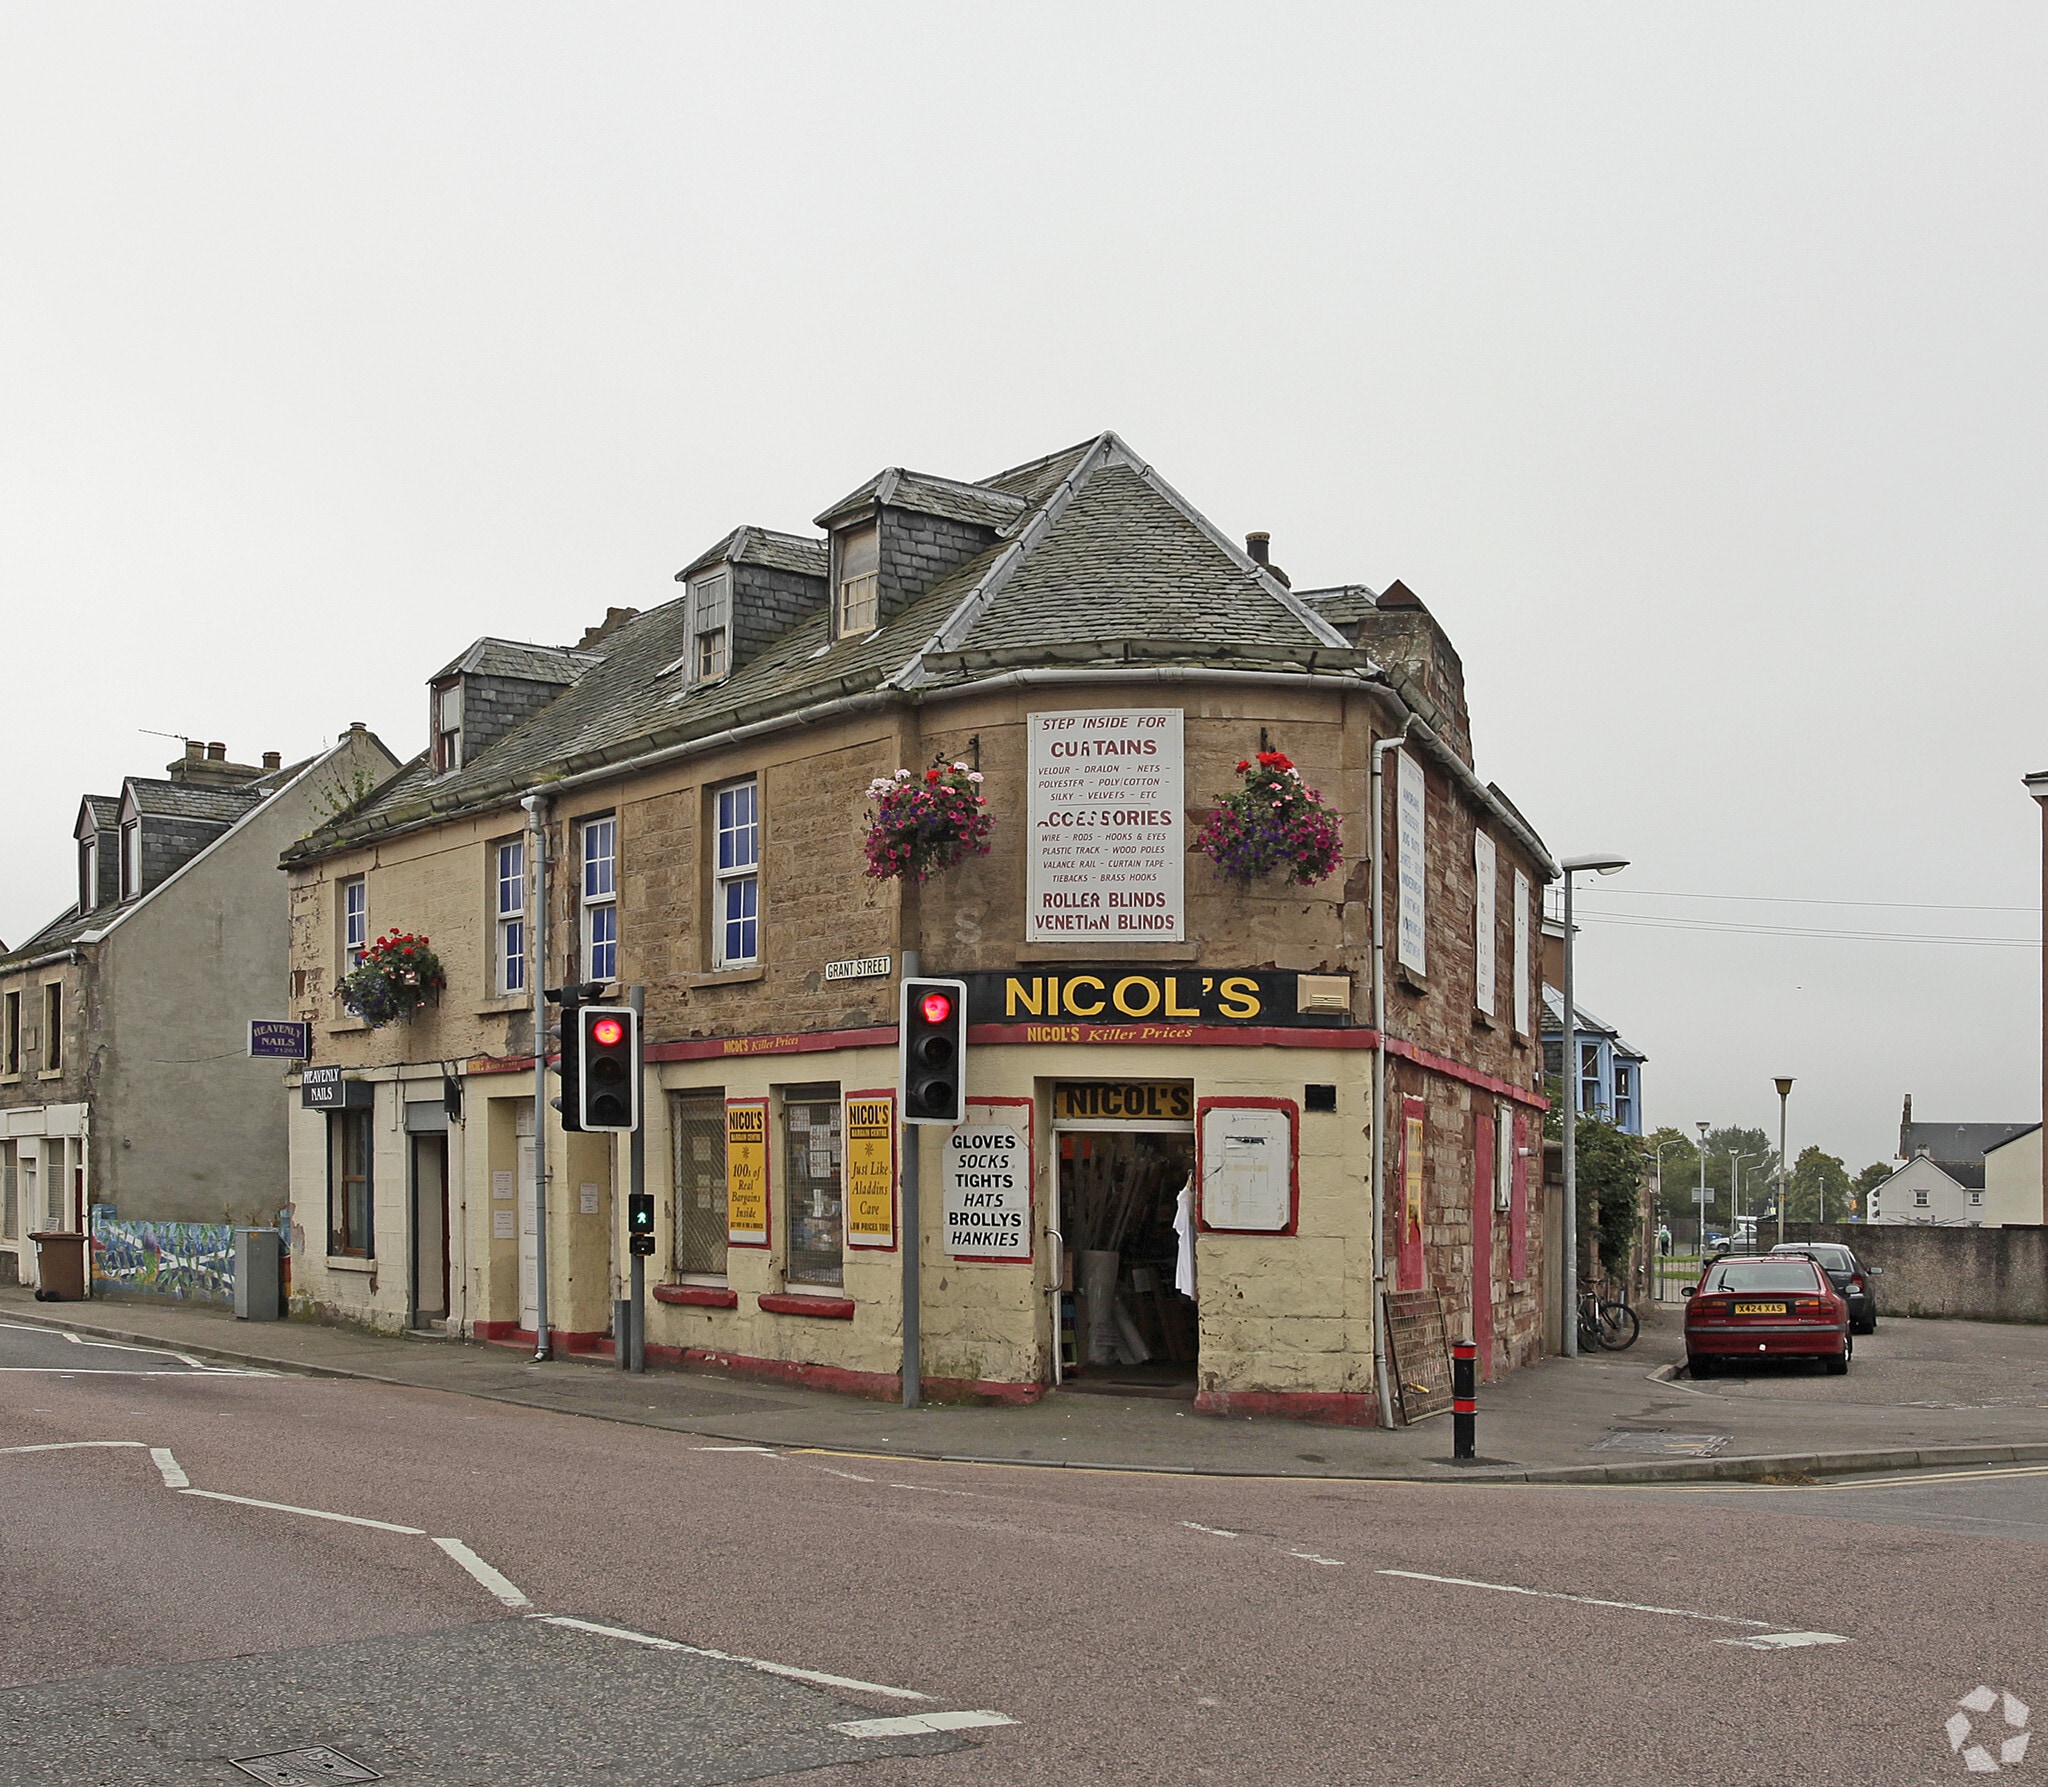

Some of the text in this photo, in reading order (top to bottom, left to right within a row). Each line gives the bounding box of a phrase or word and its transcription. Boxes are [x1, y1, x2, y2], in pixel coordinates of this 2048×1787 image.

[1043, 716, 1167, 730] STEP INSIDE FOR
[1038, 766, 1070, 775] VELOUR
[1084, 765, 1120, 774] DRALON
[1038, 780, 1084, 788] POLYESTER
[1050, 791, 1158, 801] SILKY VELVETS ETC
[1037, 810, 1172, 827] CCESSORIES
[1041, 834, 1061, 842] WIRE
[1072, 833, 1093, 841] RODS
[1042, 847, 1072, 855] PLASTIC
[1112, 846, 1136, 854] WOOD
[1079, 860, 1096, 868] RAIL
[1108, 860, 1141, 868] CURTAIN
[1100, 874, 1126, 882] BRASS
[1130, 873, 1157, 881] HOOKS
[1043, 892, 1166, 908] ROLLER BLINDS
[1118, 914, 1175, 930] BLINDS
[828, 958, 888, 978] GRANT STREET
[1005, 976, 1261, 1018] NICOL'S
[254, 1024, 302, 1038] HEAVENLY
[1027, 1027, 1193, 1041] NICOL'S Killer Prices
[261, 1038, 295, 1046] NAILS
[752, 1039, 774, 1051] Killer
[775, 1036, 799, 1048] Prices
[304, 1068, 339, 1084] HEAVENLY
[311, 1087, 333, 1101] NAILS
[1066, 1086, 1190, 1117] NICOL'S
[729, 1111, 762, 1130] NICOL'S
[849, 1105, 889, 1125] NICOL'S
[952, 1135, 1016, 1149] GLOVES
[958, 1155, 1009, 1168] SOCKS
[733, 1164, 762, 1181] 100s of
[851, 1161, 888, 1179] Just Like
[738, 1180, 753, 1190] Real
[852, 1181, 888, 1195] Aladdins
[955, 1174, 1013, 1188] TIGHTS
[731, 1192, 760, 1205] Bargains
[964, 1193, 1004, 1207] HATS
[736, 1207, 756, 1218] Inside
[860, 1200, 880, 1215] Cave
[861, 1222, 878, 1231] PRICES
[949, 1212, 1022, 1227] BROLLYS
[952, 1232, 1019, 1246] HANKIES
[1739, 1304, 1782, 1312] X424 XAS
